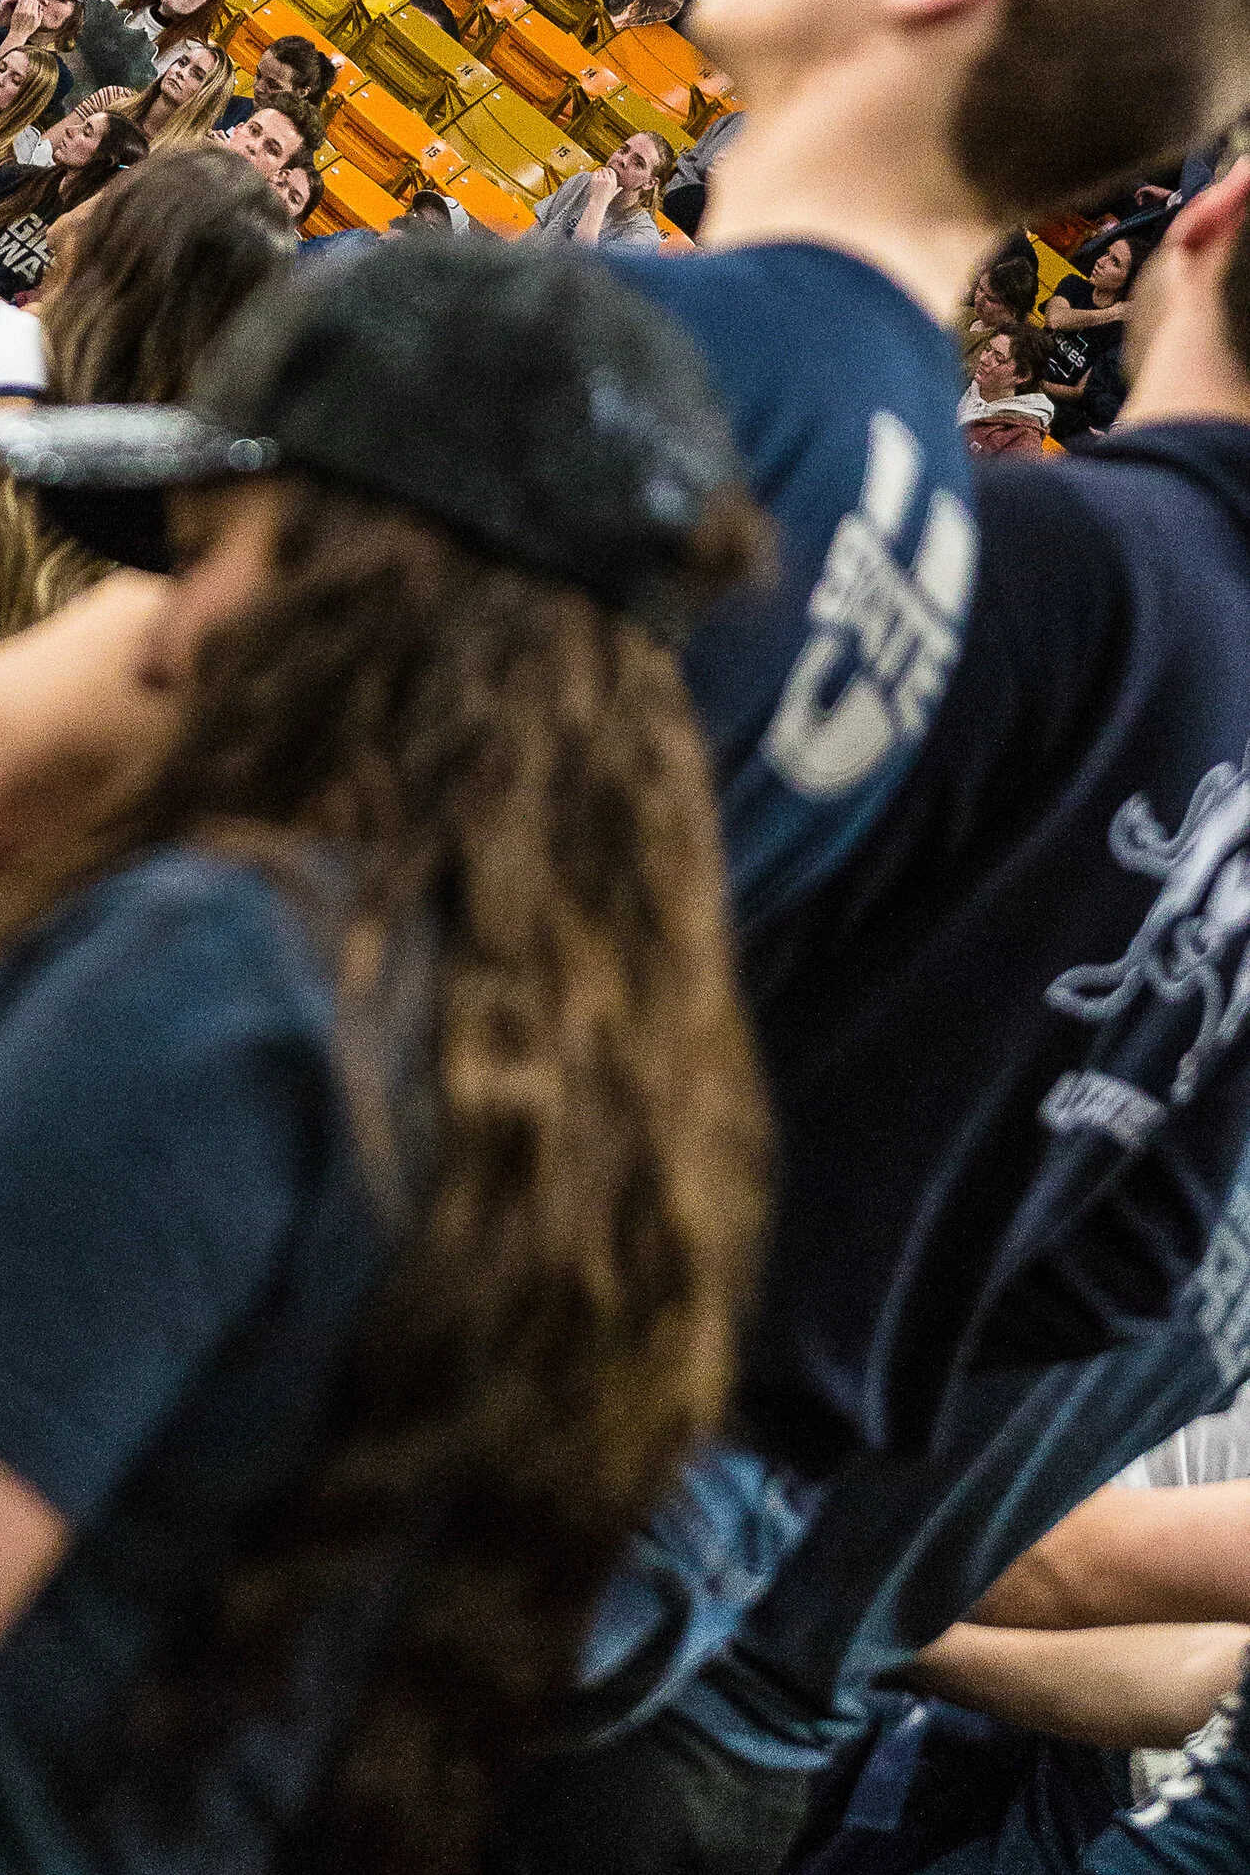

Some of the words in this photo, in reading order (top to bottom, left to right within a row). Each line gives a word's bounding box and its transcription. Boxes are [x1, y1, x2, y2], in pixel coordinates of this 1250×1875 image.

[459, 65, 474, 77] 14
[426, 146, 440, 159] 15
[556, 145, 571, 159] 15
